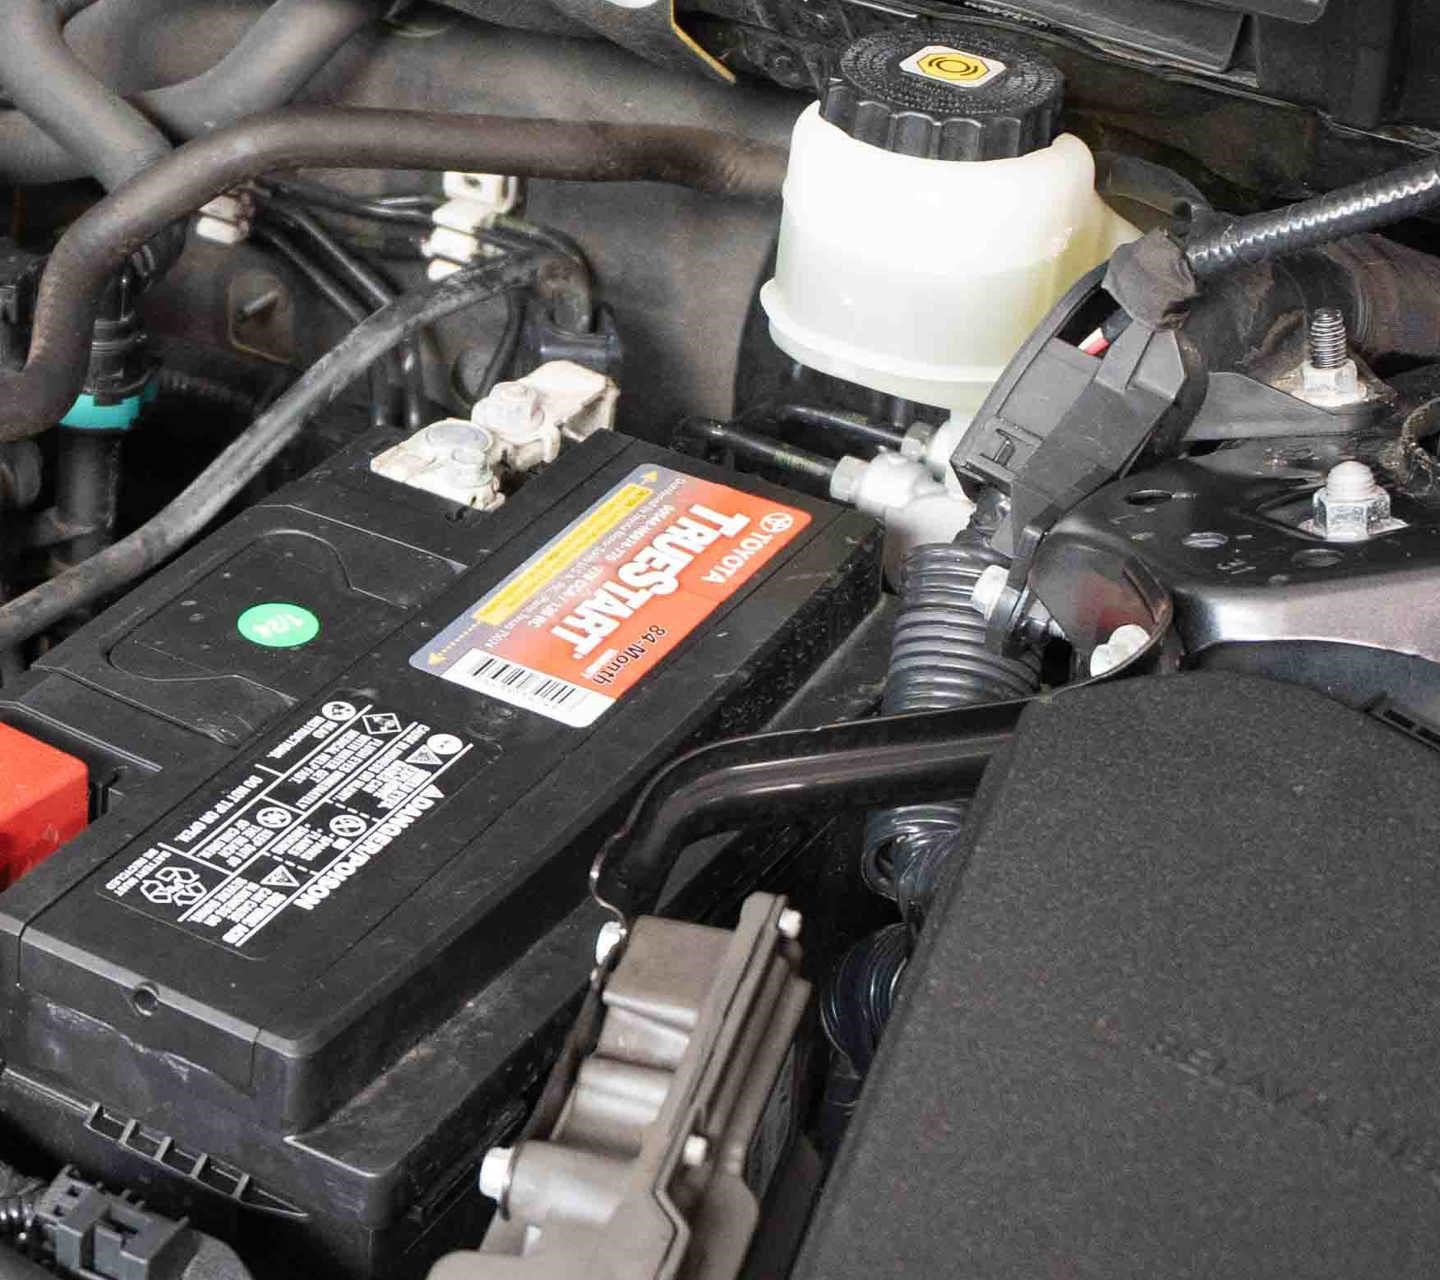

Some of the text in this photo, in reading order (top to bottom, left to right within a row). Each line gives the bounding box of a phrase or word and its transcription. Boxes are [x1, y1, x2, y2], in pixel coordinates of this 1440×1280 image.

[699, 529, 774, 586] TOYOTA
[592, 624, 666, 686] 84-Month
[293, 796, 437, 911] DANGER/POISON
